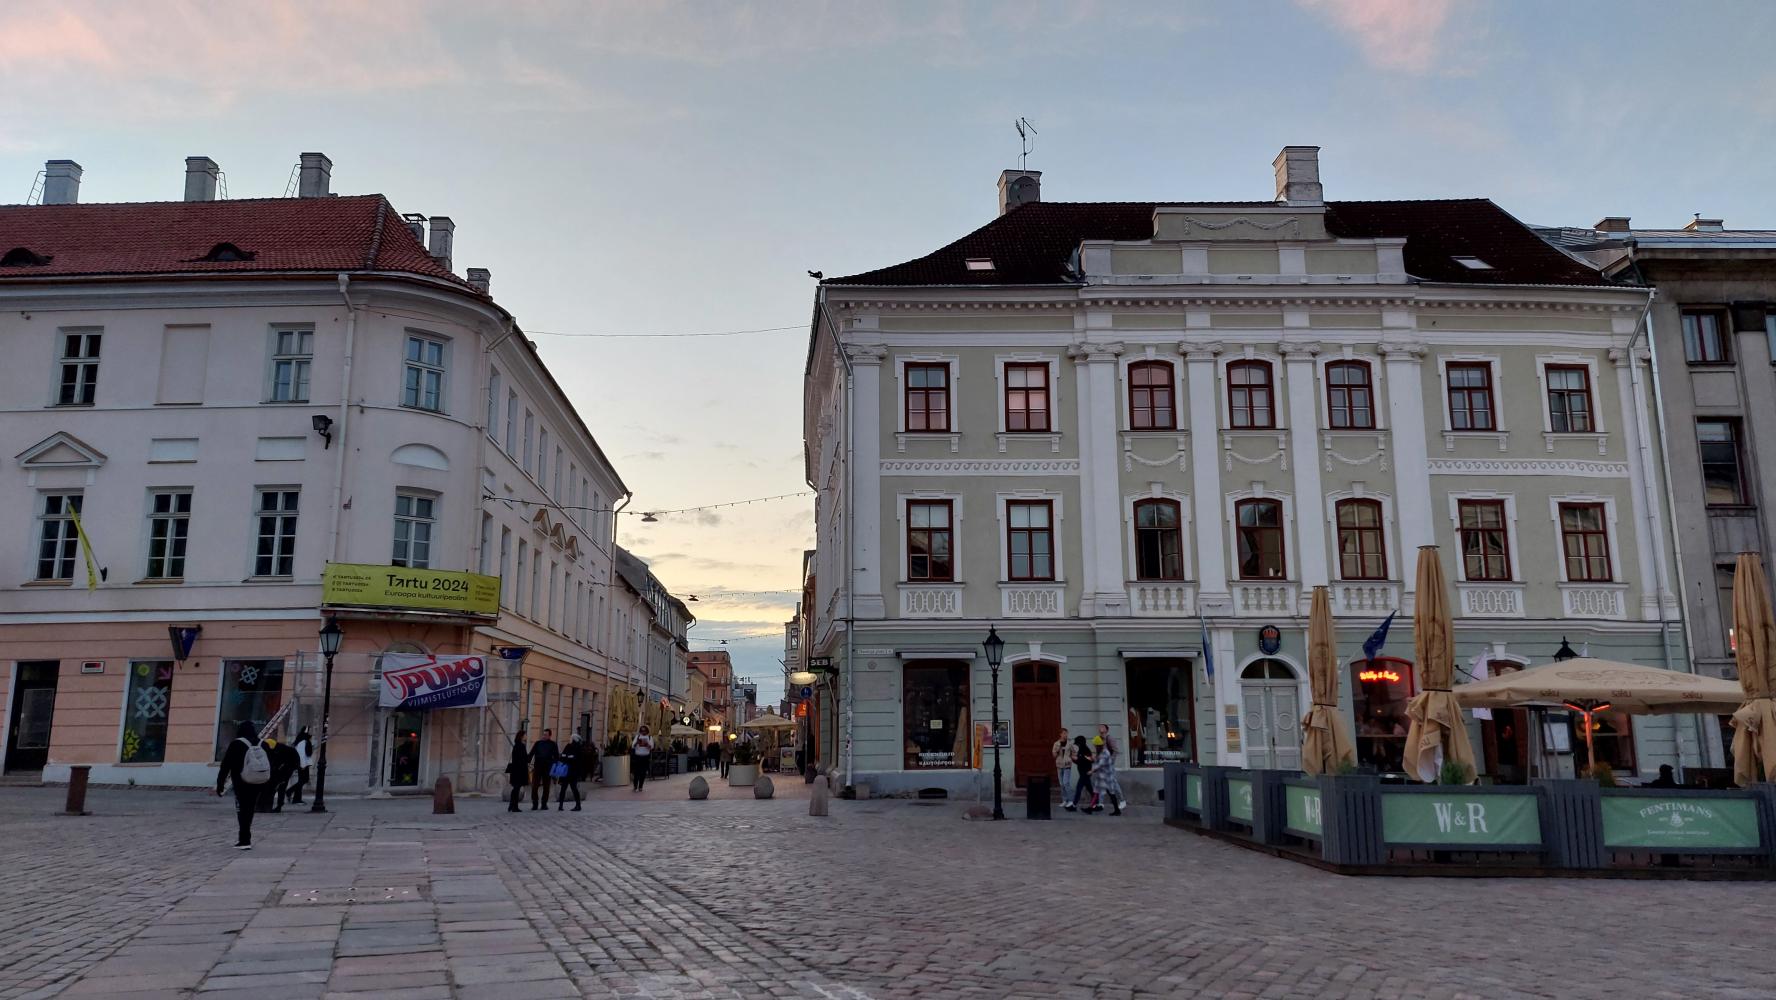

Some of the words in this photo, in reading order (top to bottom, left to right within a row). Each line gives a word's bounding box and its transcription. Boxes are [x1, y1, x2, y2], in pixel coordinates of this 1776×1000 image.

[386, 574, 428, 589] Tartu
[432, 577, 469, 593] 2024
[384, 589, 416, 599] Euroopa
[404, 656, 484, 697] PUKO
[1432, 802, 1489, 833] W&R
[1640, 802, 1713, 819] FENTIMANS
